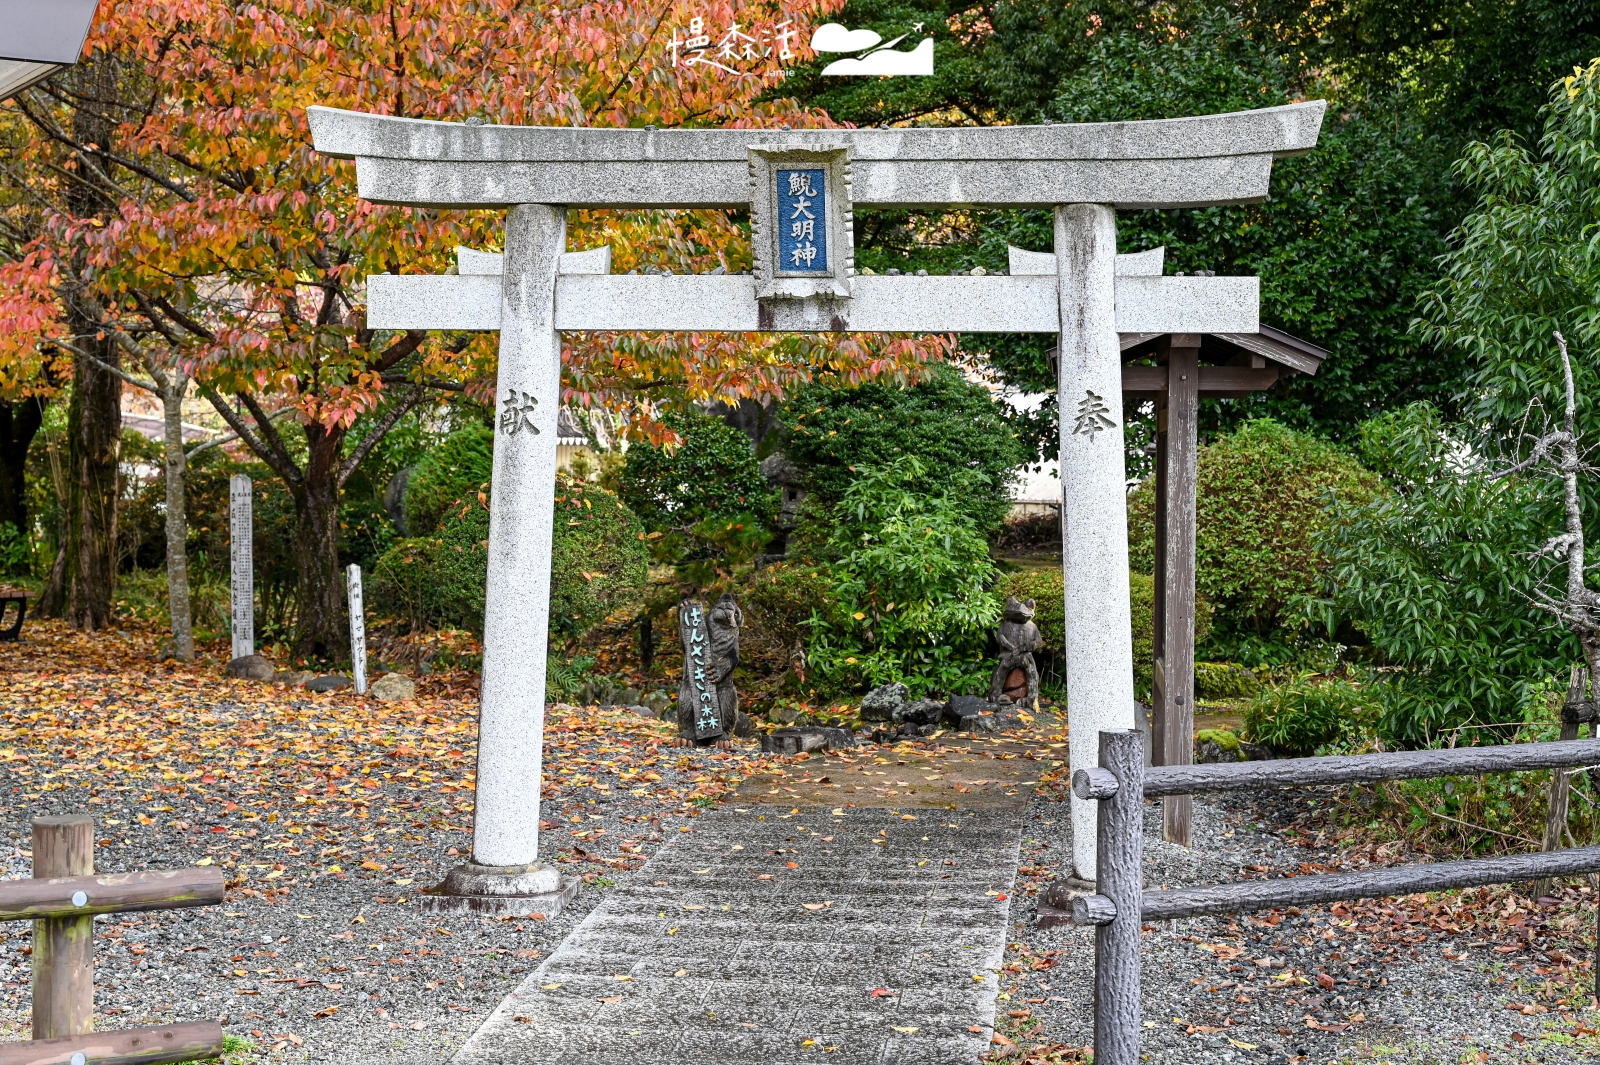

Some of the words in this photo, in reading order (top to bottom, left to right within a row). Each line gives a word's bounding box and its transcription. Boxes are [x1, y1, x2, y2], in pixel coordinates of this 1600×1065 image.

[787, 172, 818, 268] 鯢大明神
[499, 388, 541, 436] 献
[1071, 389, 1117, 443] 奉
[684, 607, 719, 731] はんざきの森
